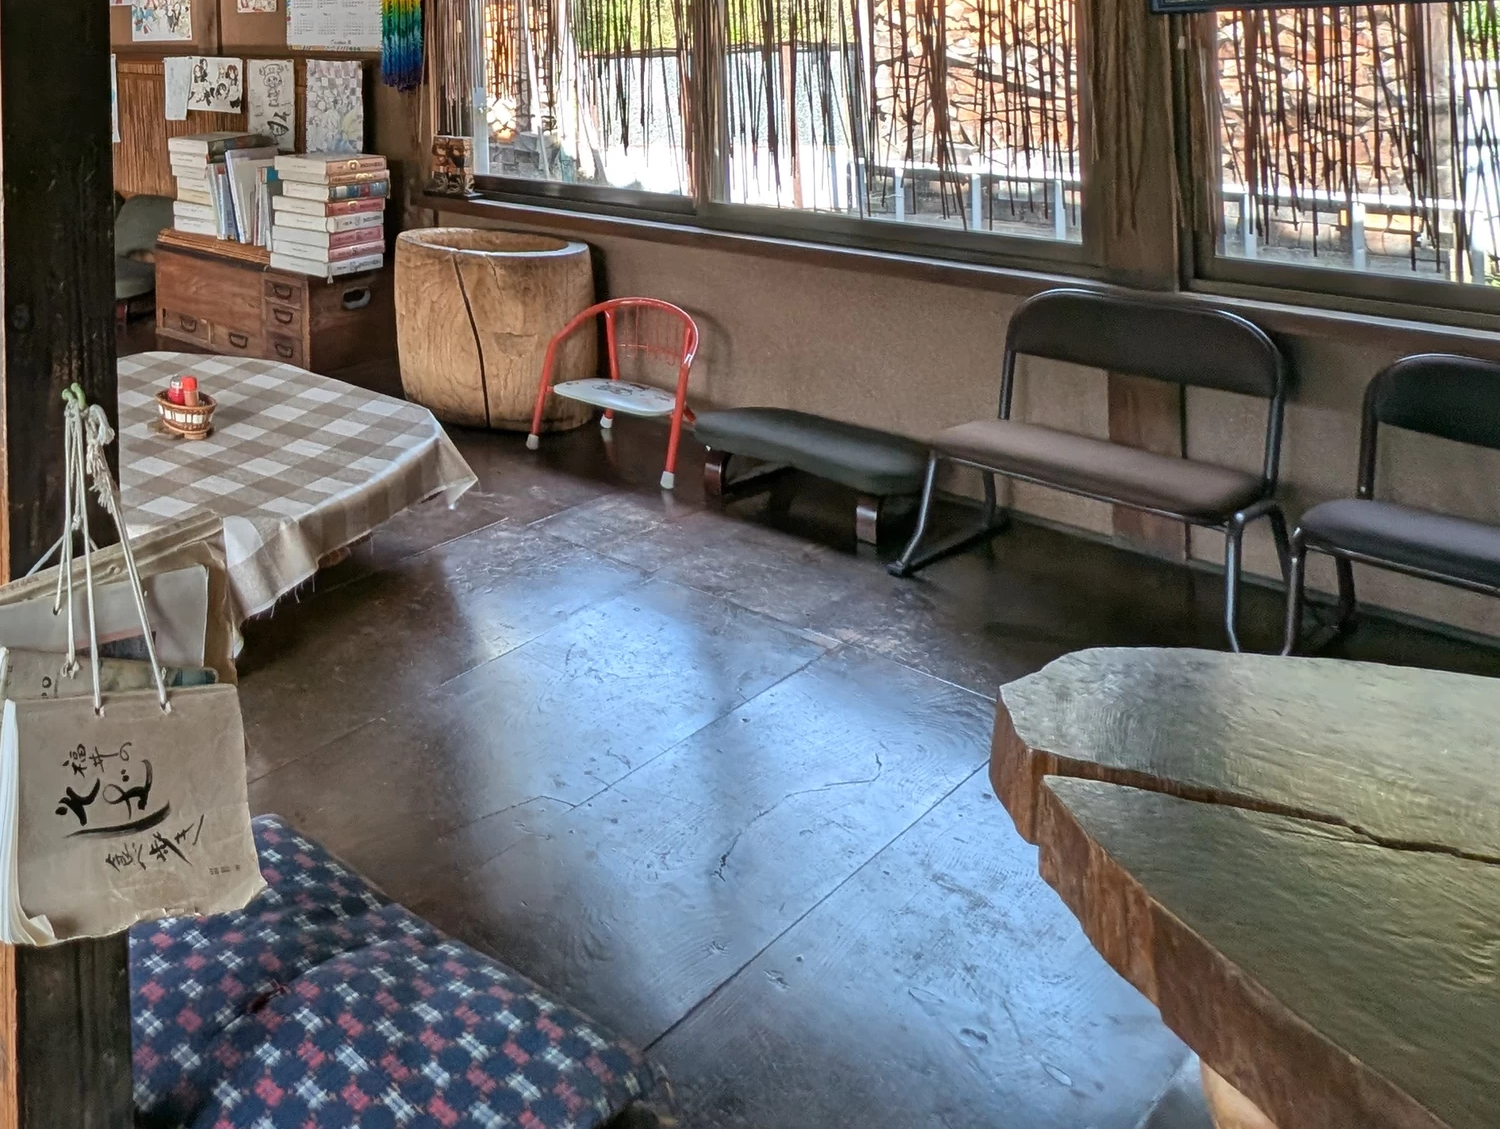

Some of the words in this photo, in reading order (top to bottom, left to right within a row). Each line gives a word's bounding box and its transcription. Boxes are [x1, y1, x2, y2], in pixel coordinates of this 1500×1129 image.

[62, 742, 132, 778] 福井の
[55, 759, 153, 826] そば
